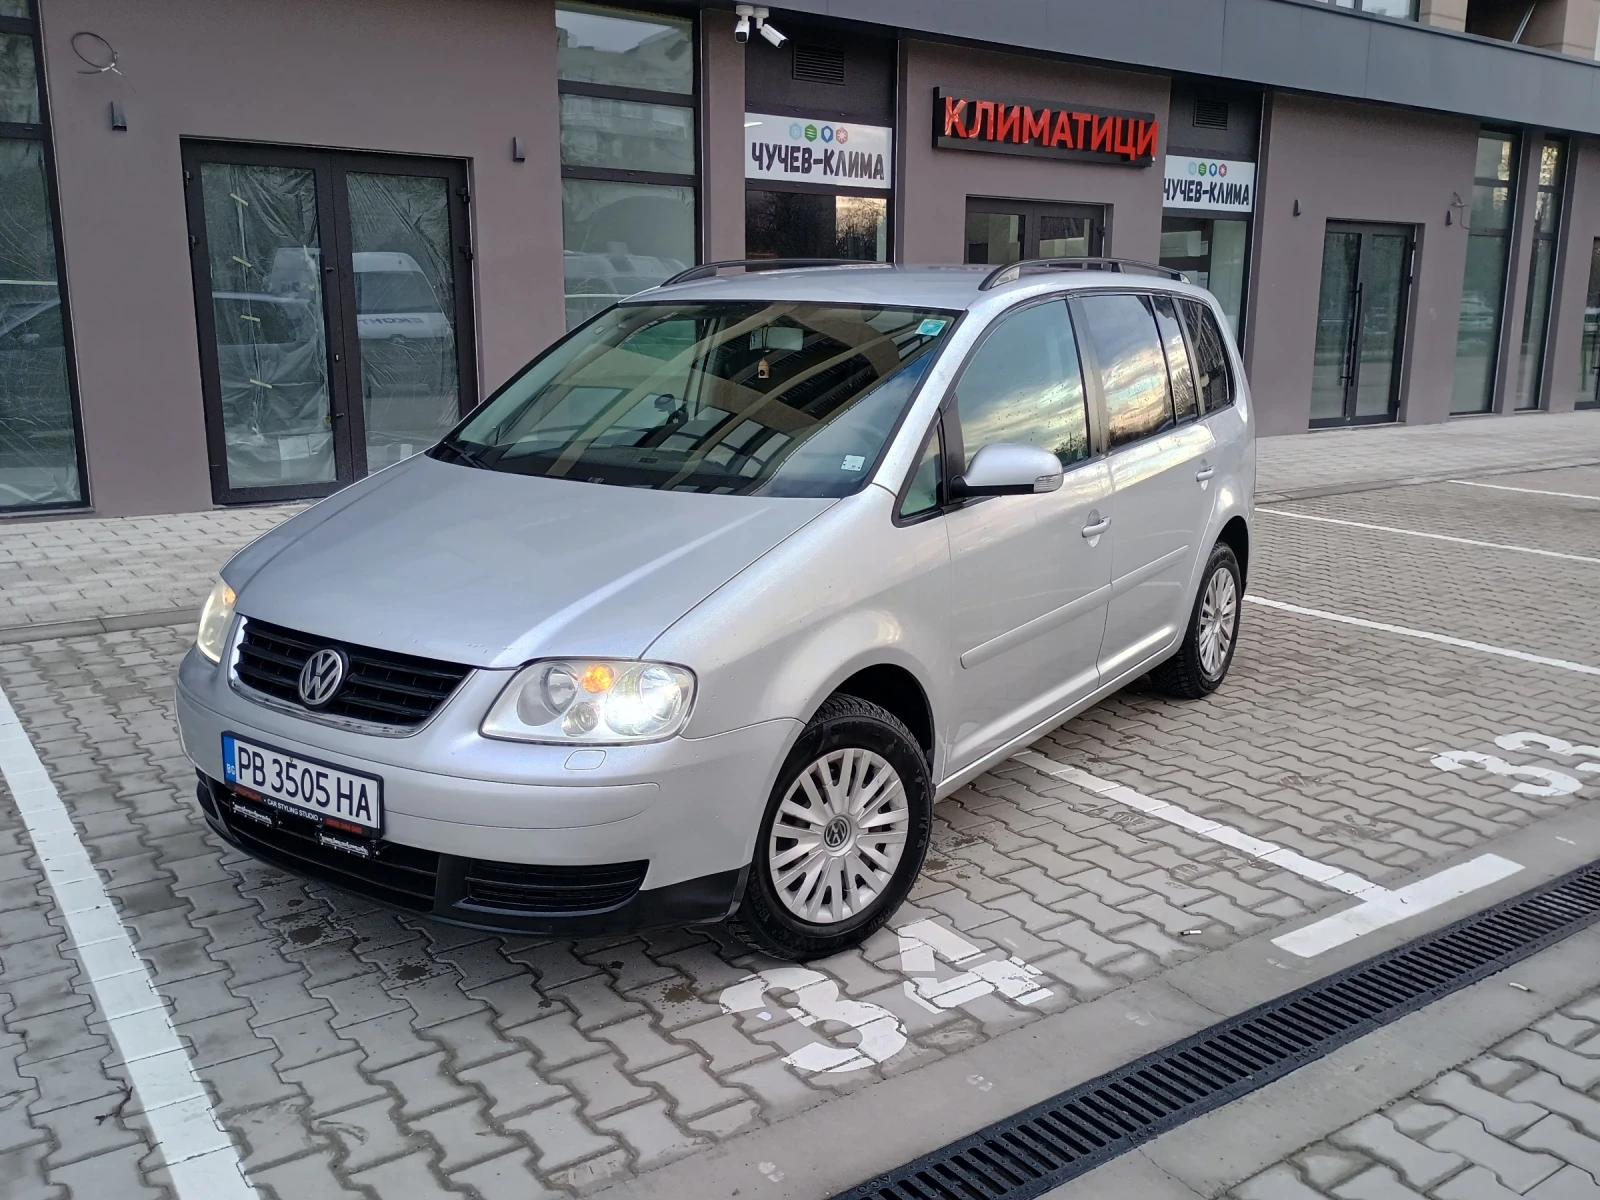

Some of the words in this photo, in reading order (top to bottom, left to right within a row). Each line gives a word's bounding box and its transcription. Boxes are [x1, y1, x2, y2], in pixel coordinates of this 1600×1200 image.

[944, 96, 1159, 161] КЛИМАТИЦИ
[751, 141, 885, 181] ЧУЧЕВ-КЛИМА
[1163, 177, 1250, 206] ЧУЧЕВ-КЛИМА
[237, 745, 266, 787] PB
[270, 758, 331, 808] 3505
[336, 776, 372, 822] HA
[267, 799, 278, 808] CAR
[277, 802, 299, 815] STYLING
[299, 809, 319, 821] STUDIO
[718, 919, 1056, 1074] 34
